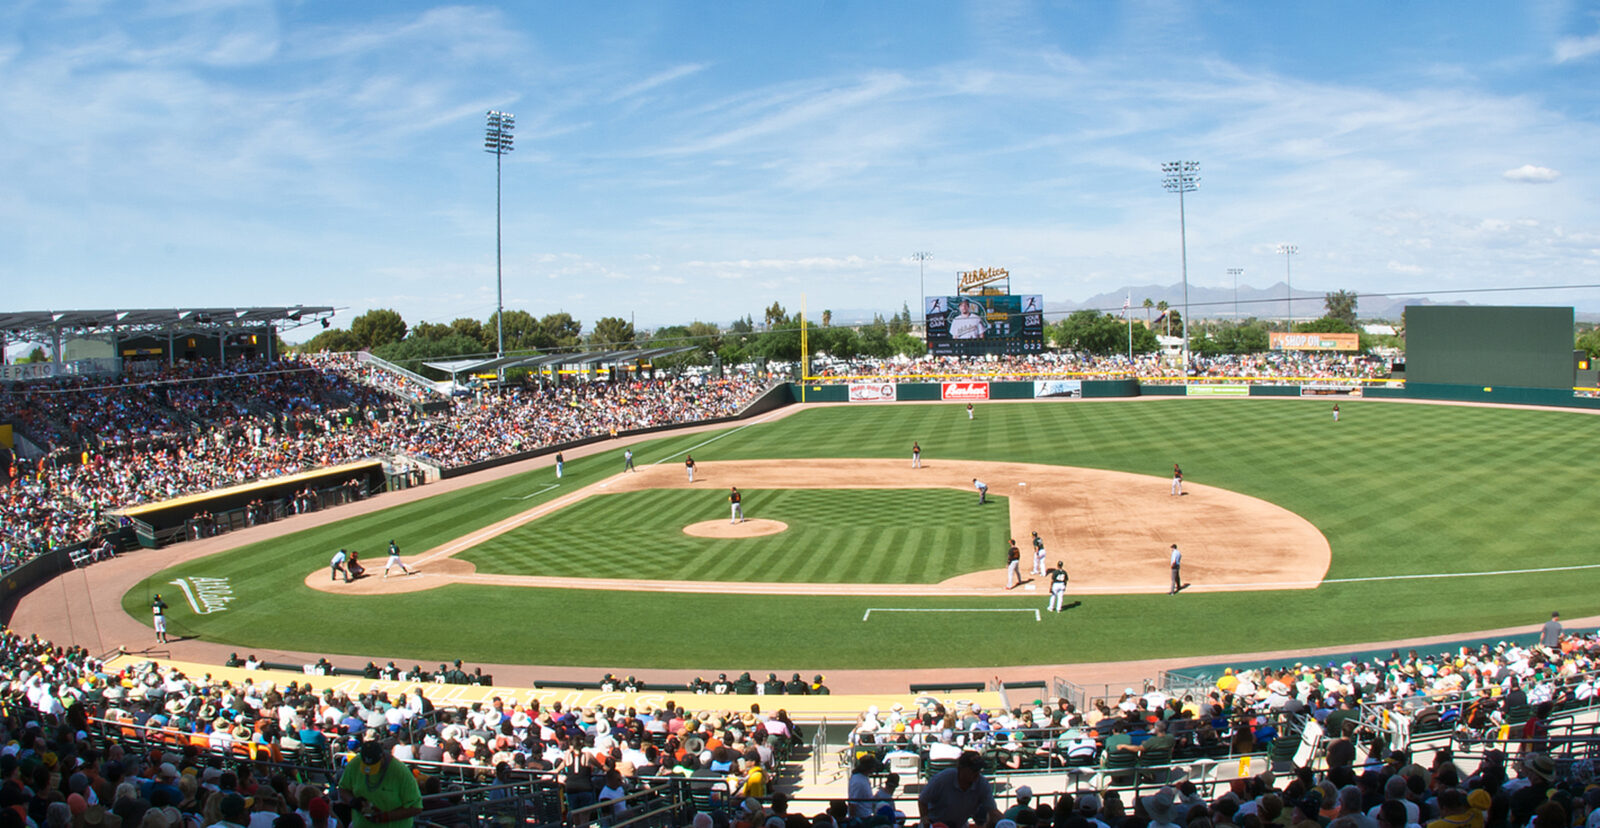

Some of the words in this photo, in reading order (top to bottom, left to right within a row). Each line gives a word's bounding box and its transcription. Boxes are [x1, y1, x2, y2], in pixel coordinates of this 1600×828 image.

[959, 266, 1009, 290] Athletics
[1285, 335, 1306, 347] SHOP
[1307, 335, 1320, 347] ON
[15, 364, 51, 377] PATIO
